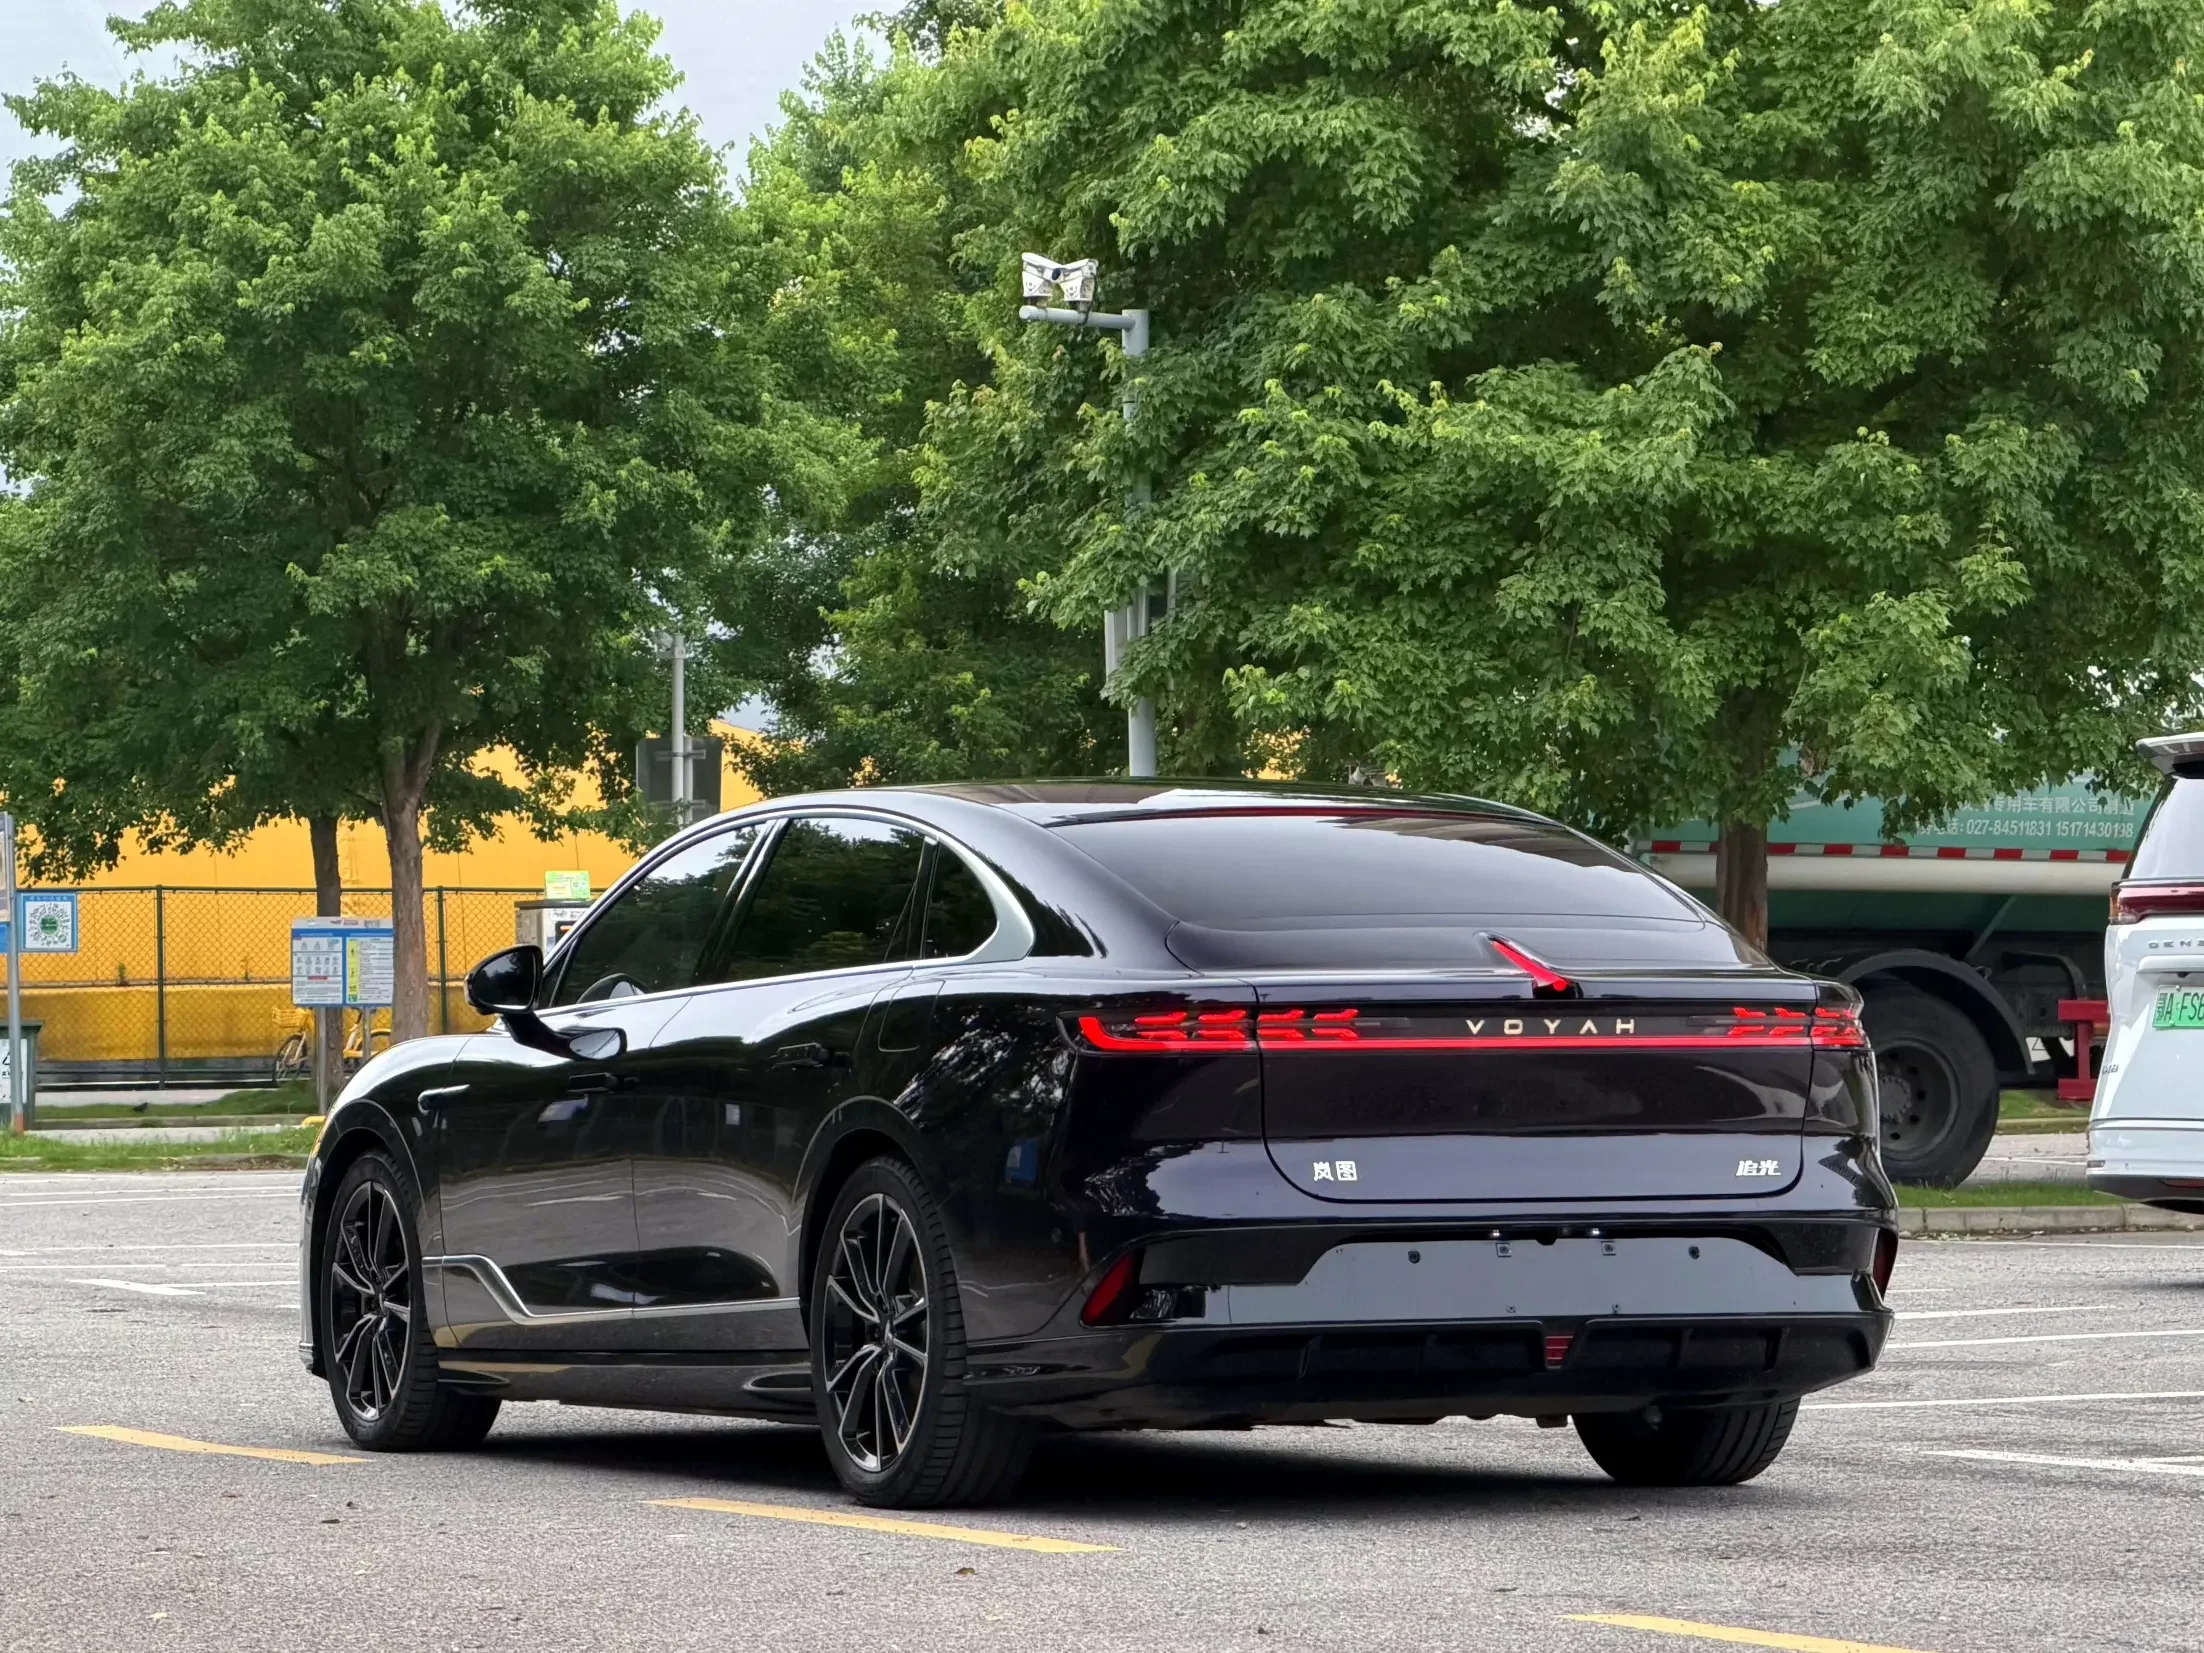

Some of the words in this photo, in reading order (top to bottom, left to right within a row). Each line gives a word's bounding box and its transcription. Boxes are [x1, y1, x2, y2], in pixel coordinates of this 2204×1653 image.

[1465, 1018, 1635, 1035] VOYAH
[1313, 1160, 1358, 1182] 岚图
[1735, 1159, 1782, 1177] 追光
